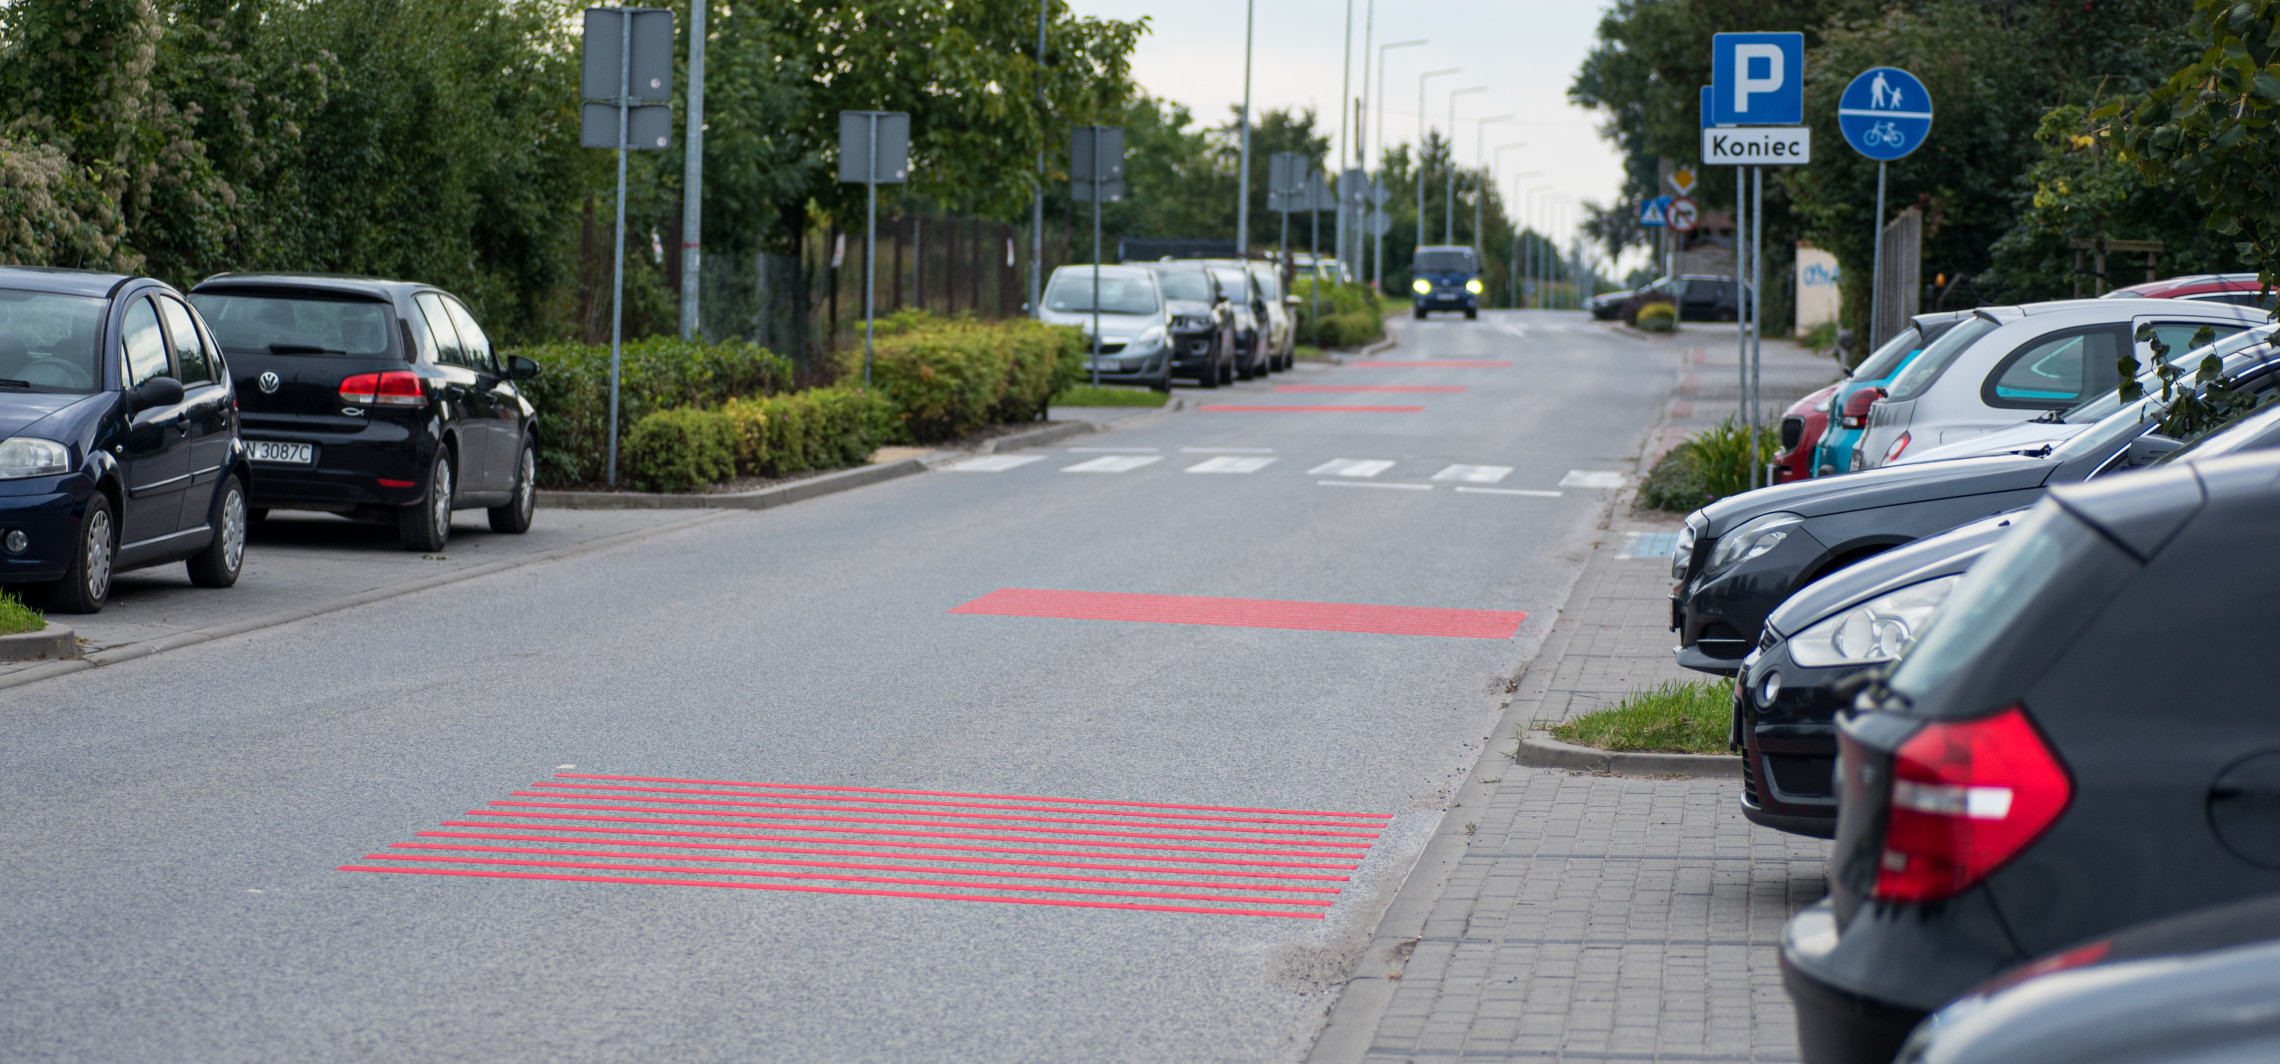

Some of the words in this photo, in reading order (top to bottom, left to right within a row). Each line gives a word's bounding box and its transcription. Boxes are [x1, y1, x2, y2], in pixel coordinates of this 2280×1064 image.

[1734, 43, 1785, 113] P
[1713, 135, 1800, 157] Koniec
[260, 443, 310, 462] 3087C
